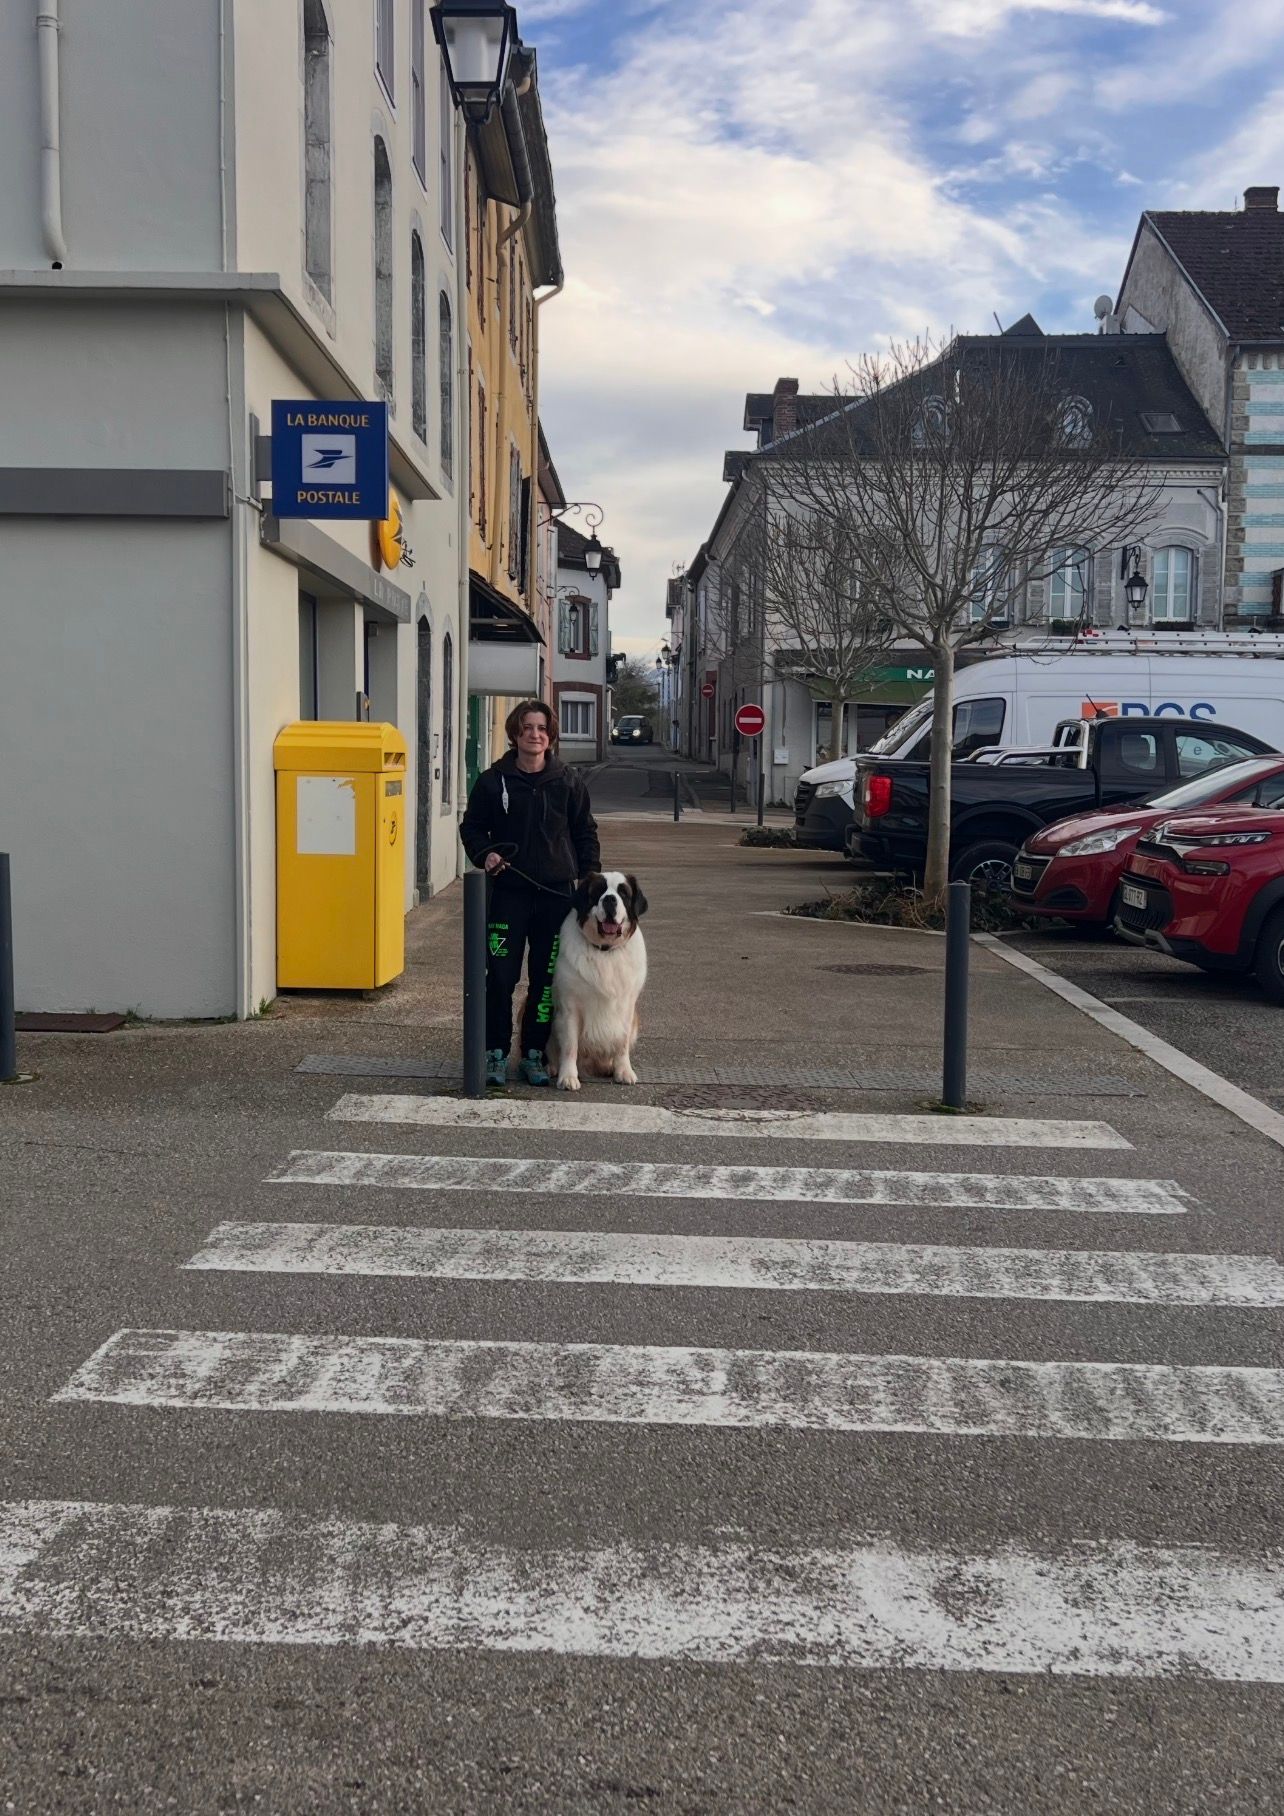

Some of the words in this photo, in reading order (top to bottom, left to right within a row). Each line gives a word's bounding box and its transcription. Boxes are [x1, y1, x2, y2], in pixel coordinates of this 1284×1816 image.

[287, 413, 305, 426] LA
[308, 414, 370, 429] BANQUE
[297, 490, 360, 504] POSTALE
[906, 669, 936, 680] NA
